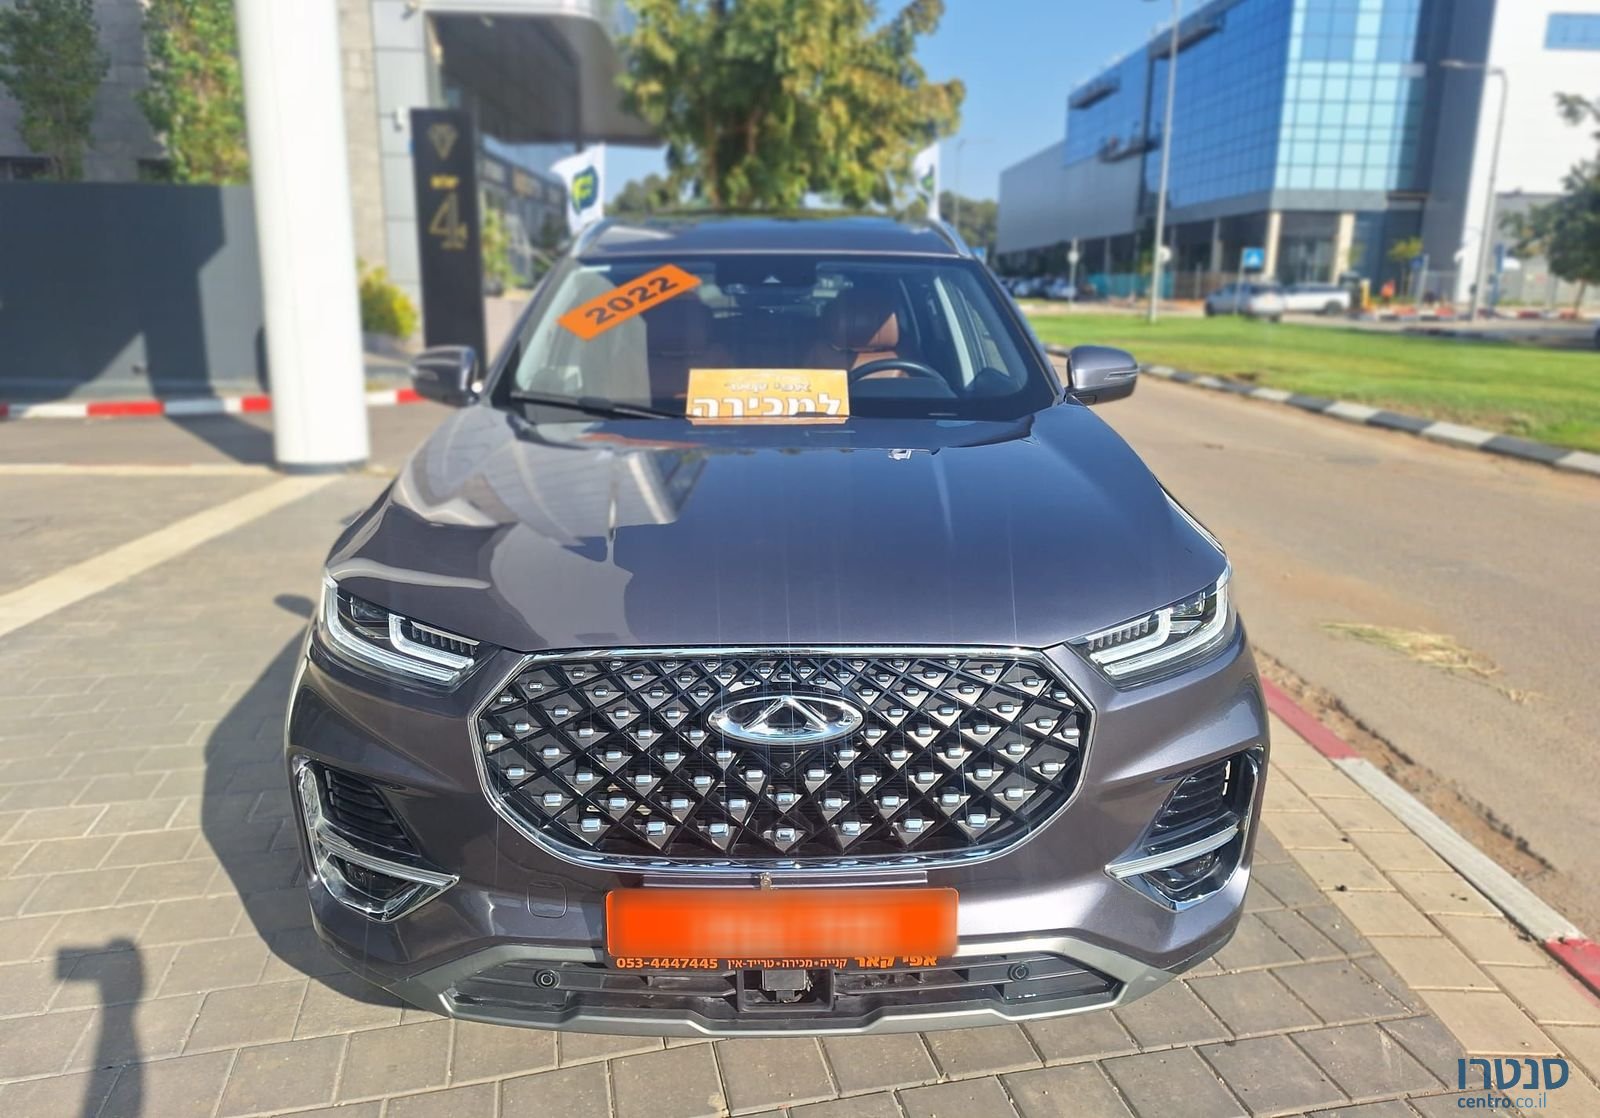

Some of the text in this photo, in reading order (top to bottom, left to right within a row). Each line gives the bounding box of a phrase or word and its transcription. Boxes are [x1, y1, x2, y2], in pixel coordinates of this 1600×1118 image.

[585, 276, 679, 326] 2022
[691, 393, 841, 417] למכירה
[616, 957, 718, 969] 053-4447445
